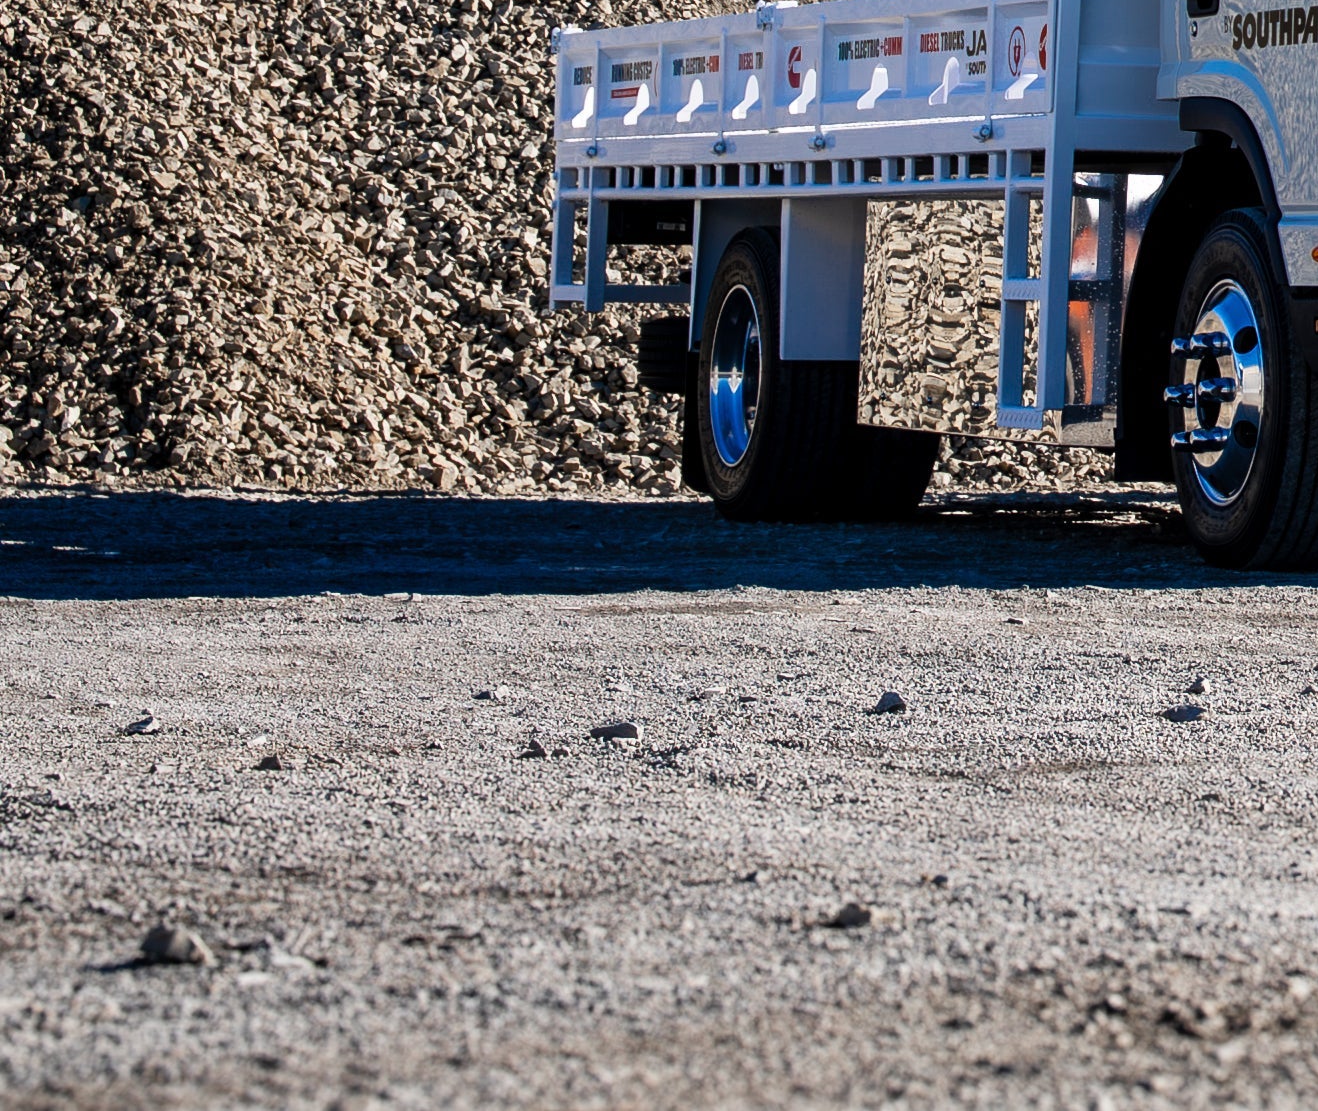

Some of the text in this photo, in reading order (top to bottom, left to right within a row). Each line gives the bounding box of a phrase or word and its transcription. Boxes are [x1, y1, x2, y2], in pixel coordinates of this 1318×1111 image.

[1223, 15, 1233, 34] BY
[854, 38, 879, 59] ELECTRIC
[920, 32, 940, 53] DIESEL
[940, 30, 965, 51] TRUCKS
